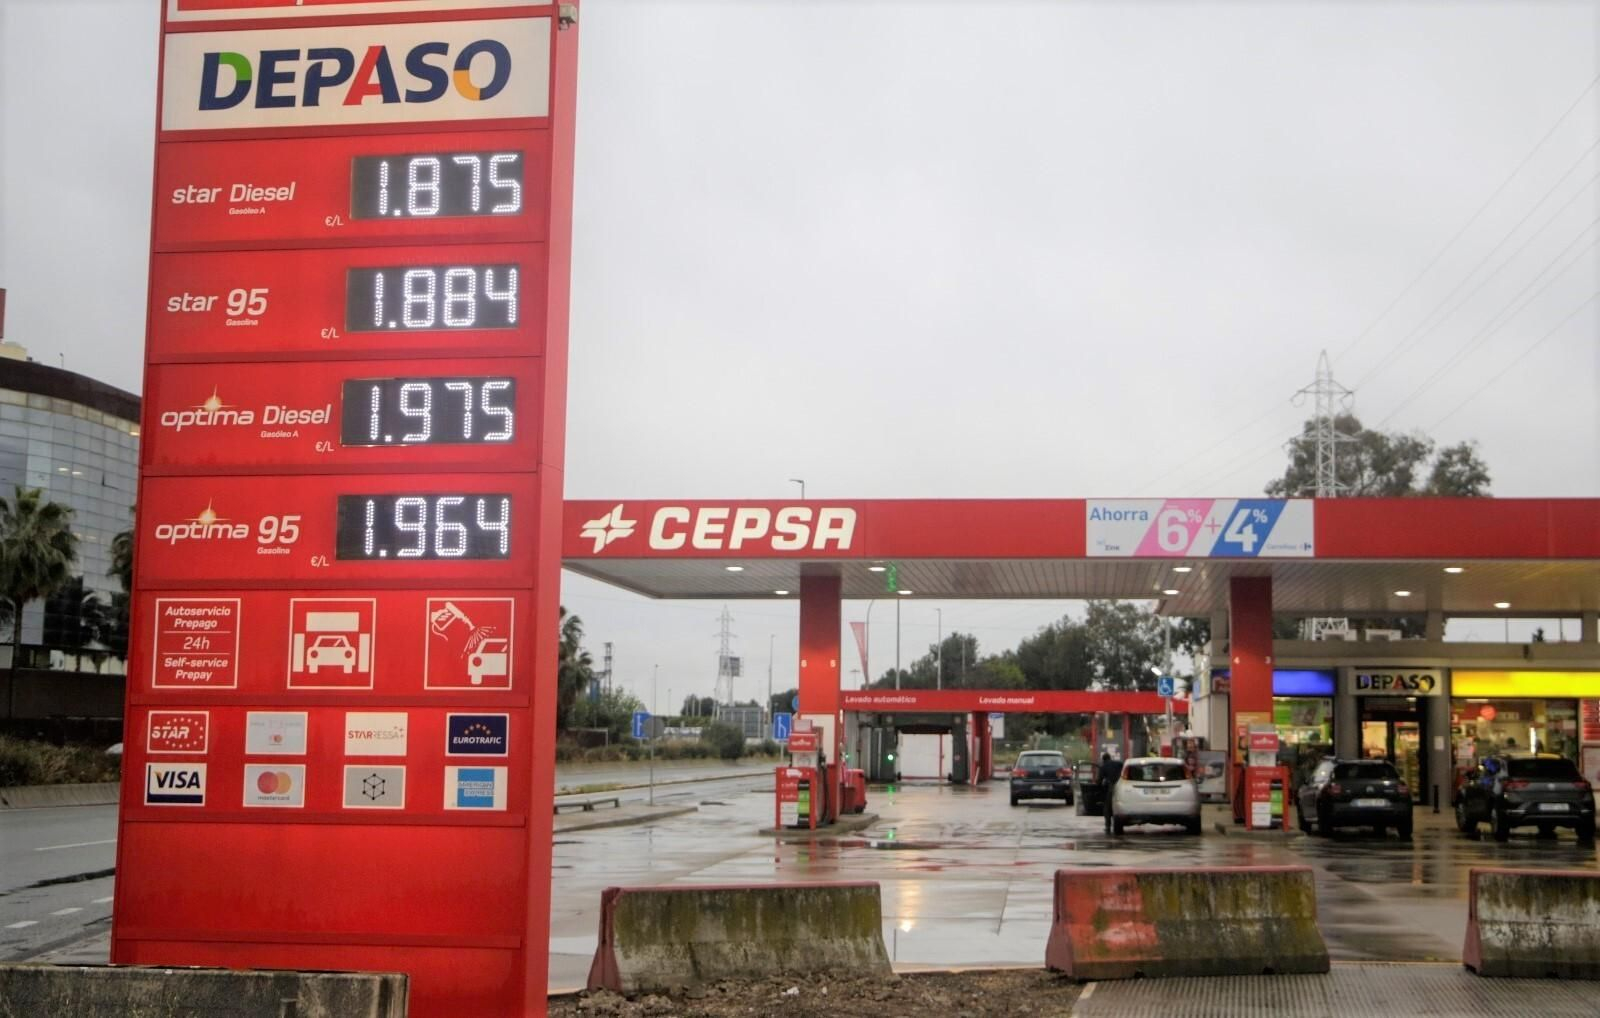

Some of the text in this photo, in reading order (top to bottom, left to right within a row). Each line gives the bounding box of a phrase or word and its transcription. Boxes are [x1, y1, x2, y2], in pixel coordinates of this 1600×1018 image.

[199, 39, 512, 111] DEPASO
[378, 154, 521, 216] 1.875
[172, 182, 297, 204] star Diesel
[325, 215, 344, 228] €/L
[166, 288, 269, 316] star 95
[374, 268, 518, 327] 1.884
[226, 318, 258, 327] Gasolina
[321, 327, 340, 339] €/L
[369, 380, 514, 442] 1.975
[161, 404, 332, 432] optima Diesel
[260, 429, 299, 438] Gasóleo A
[315, 441, 334, 453] €/L
[1089, 507, 1149, 521] Ahorra
[155, 516, 301, 545] optima 95
[364, 496, 510, 557] 1.964
[649, 506, 857, 551] CEPSA
[257, 547, 290, 555] Gasolina
[310, 556, 330, 567] €/L
[165, 606, 231, 616] Autoservicio
[174, 618, 218, 630] Prepago
[183, 636, 210, 650] 24h
[164, 657, 229, 668] Self-service
[175, 669, 213, 681] Prepay
[1356, 674, 1435, 693] DEPASO
[845, 695, 917, 704] Lavado automático
[979, 696, 1035, 704] Lavado manual
[151, 726, 190, 739] STAR
[452, 736, 502, 744] EUROTRAFIC
[155, 771, 201, 789] VISA
